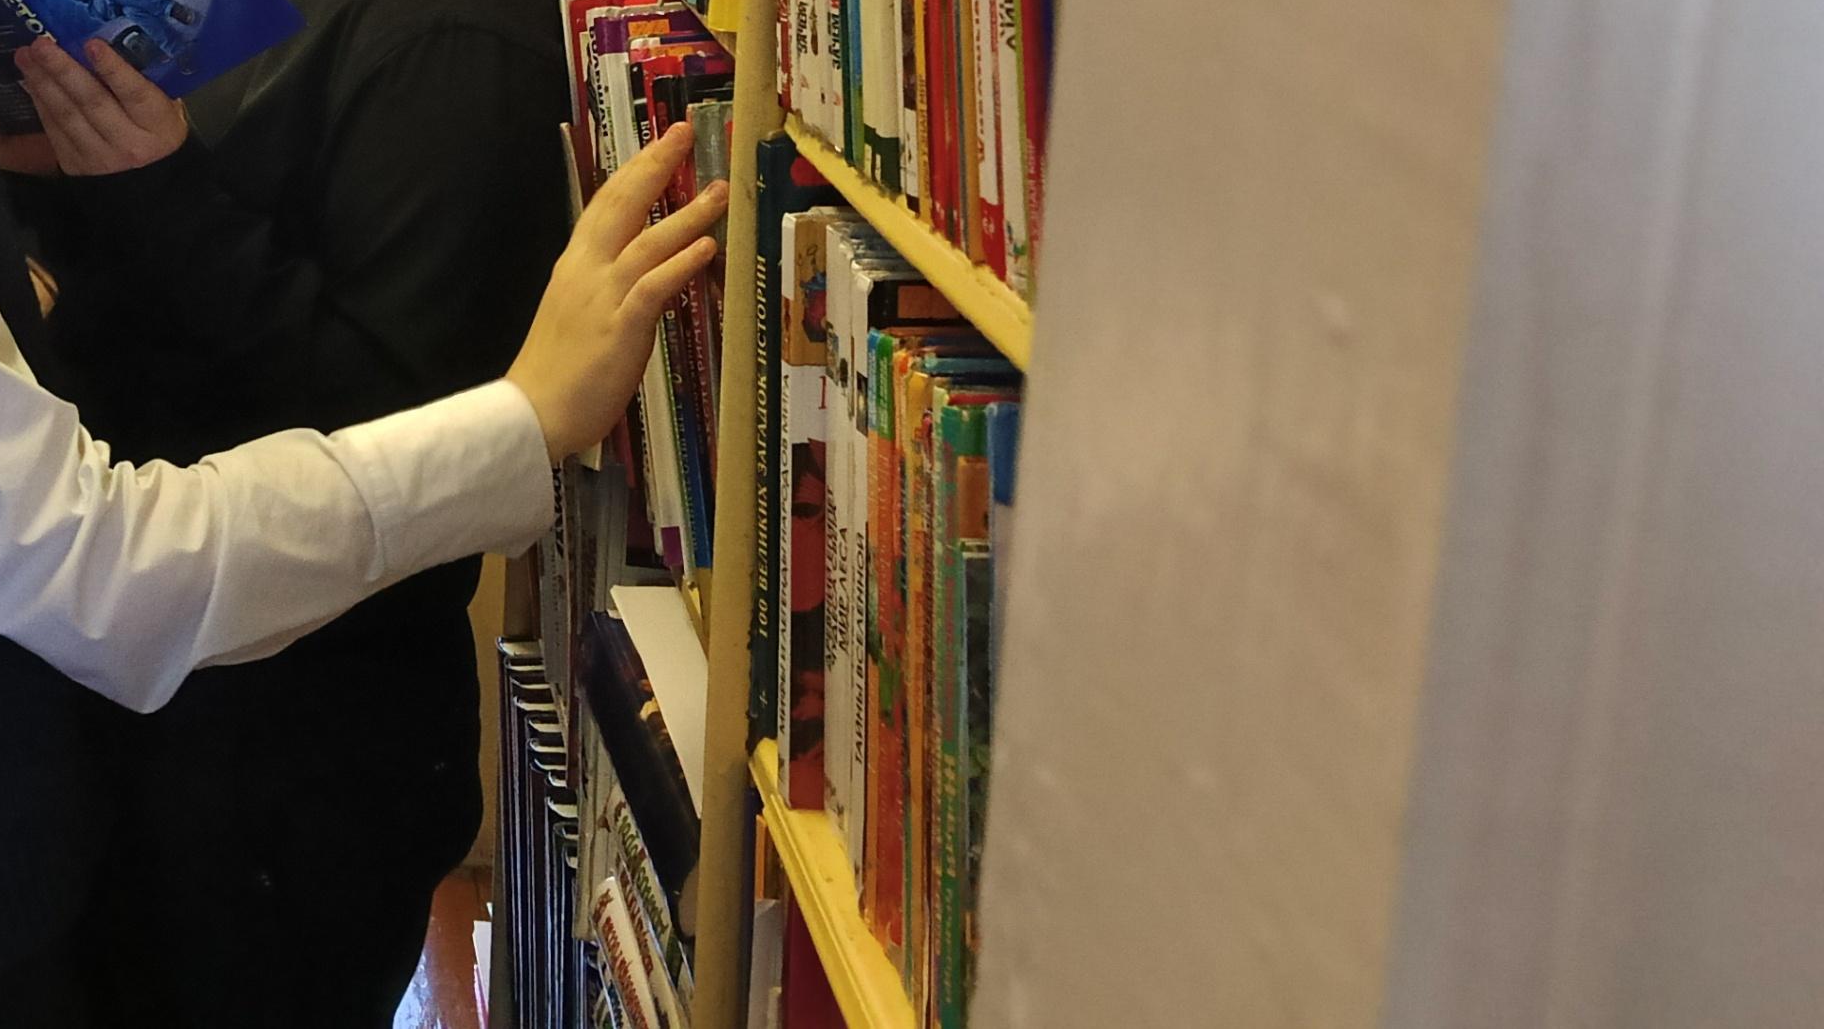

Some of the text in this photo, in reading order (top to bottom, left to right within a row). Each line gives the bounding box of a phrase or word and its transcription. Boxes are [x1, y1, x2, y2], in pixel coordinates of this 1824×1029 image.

[795, 0, 808, 54] ЗАЧЕМ
[829, 11, 843, 70] ЗАЧЕМ
[781, 373, 790, 435] МИРА
[756, 253, 769, 639] 100 ВЕЛИКИХ ЗАГАДОК ИСТОРИИ
[780, 437, 790, 546] НАРОДОВ
[836, 525, 849, 594] ЛЕСА
[779, 549, 789, 642] ЛЕГЕНДЫ
[854, 530, 866, 763] ТАЙНЫ ВСЕЛЕННОЙ
[778, 668, 787, 735] МИФЫ
